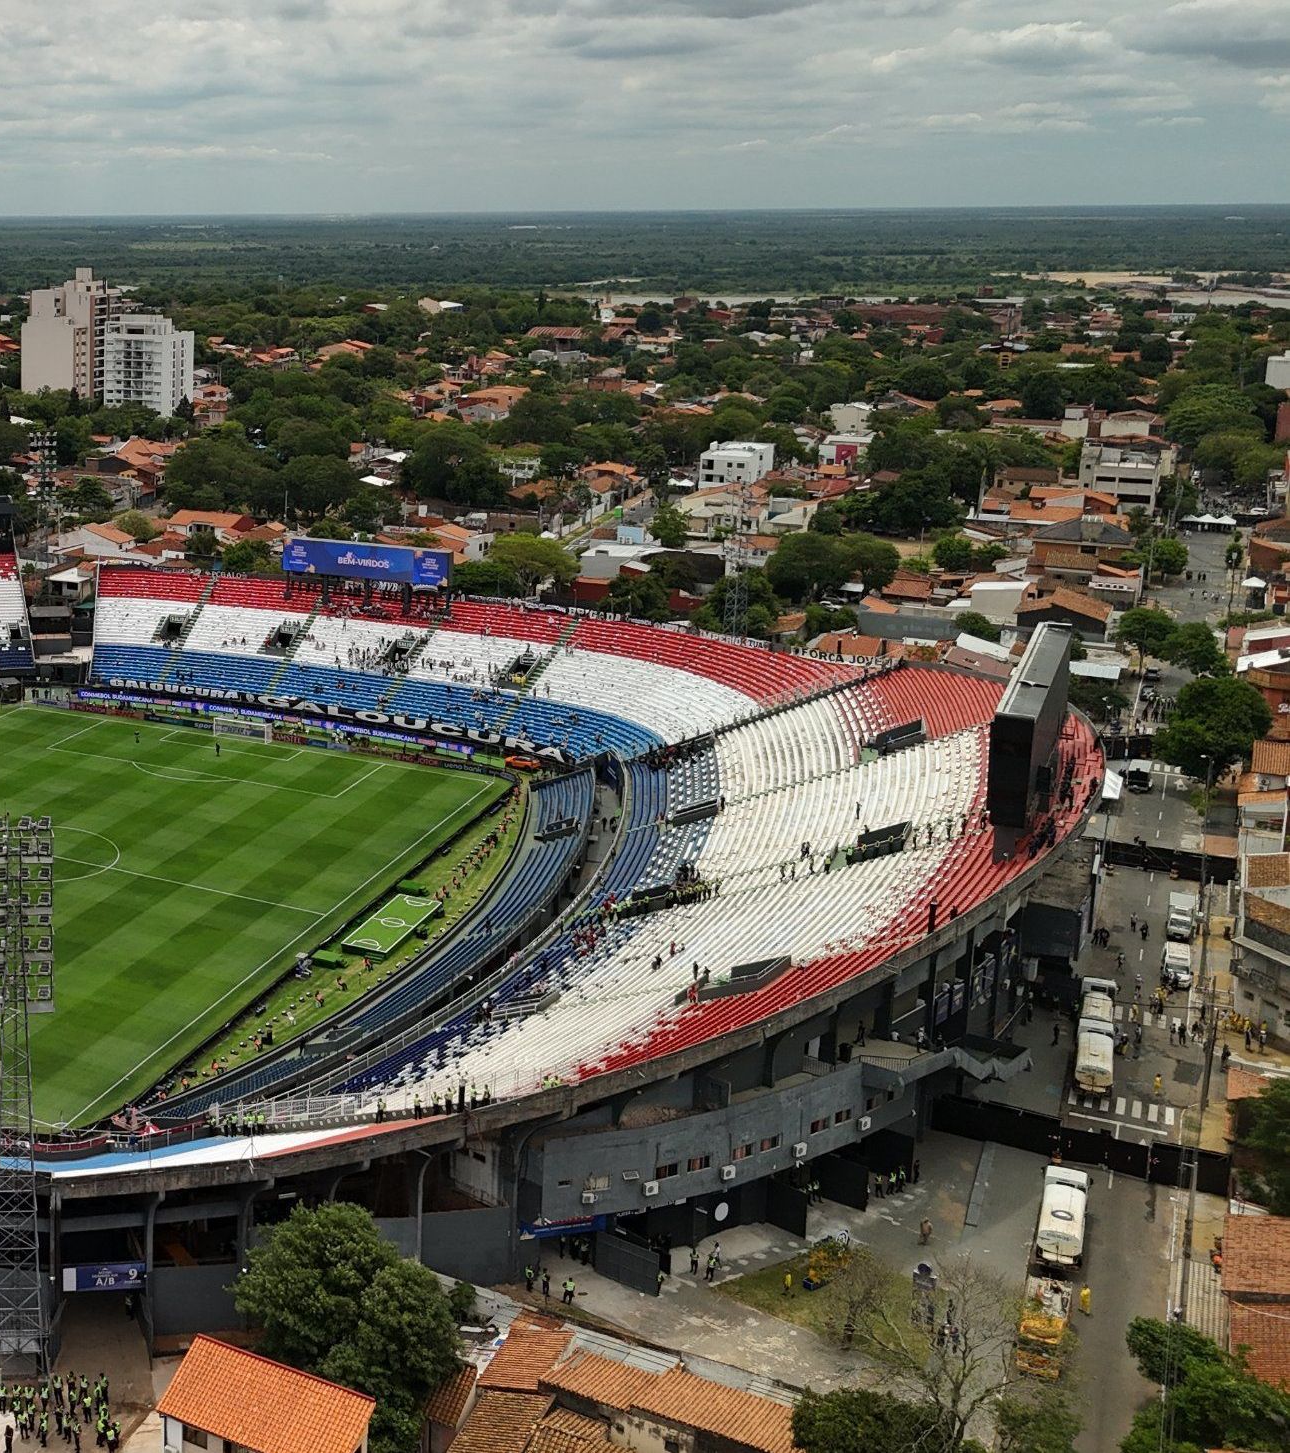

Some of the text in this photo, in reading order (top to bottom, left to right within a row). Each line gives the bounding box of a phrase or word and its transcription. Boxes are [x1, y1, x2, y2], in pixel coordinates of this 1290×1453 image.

[337, 556, 390, 569] BEM-VINDOS
[109, 678, 239, 699] GALOUCURA
[80, 691, 153, 704] CONMEBOL SUDAMERICANA
[209, 705, 283, 720] CONMEBOL SUDAMERICANA
[257, 695, 565, 763] GALOUCURA
[339, 725, 416, 743] CONMEBOL SUDAMERICANA
[275, 733, 301, 744] AMSTEL
[464, 764, 482, 773] bank
[128, 1268, 138, 1280] 9
[95, 1277, 115, 1287] A/B
